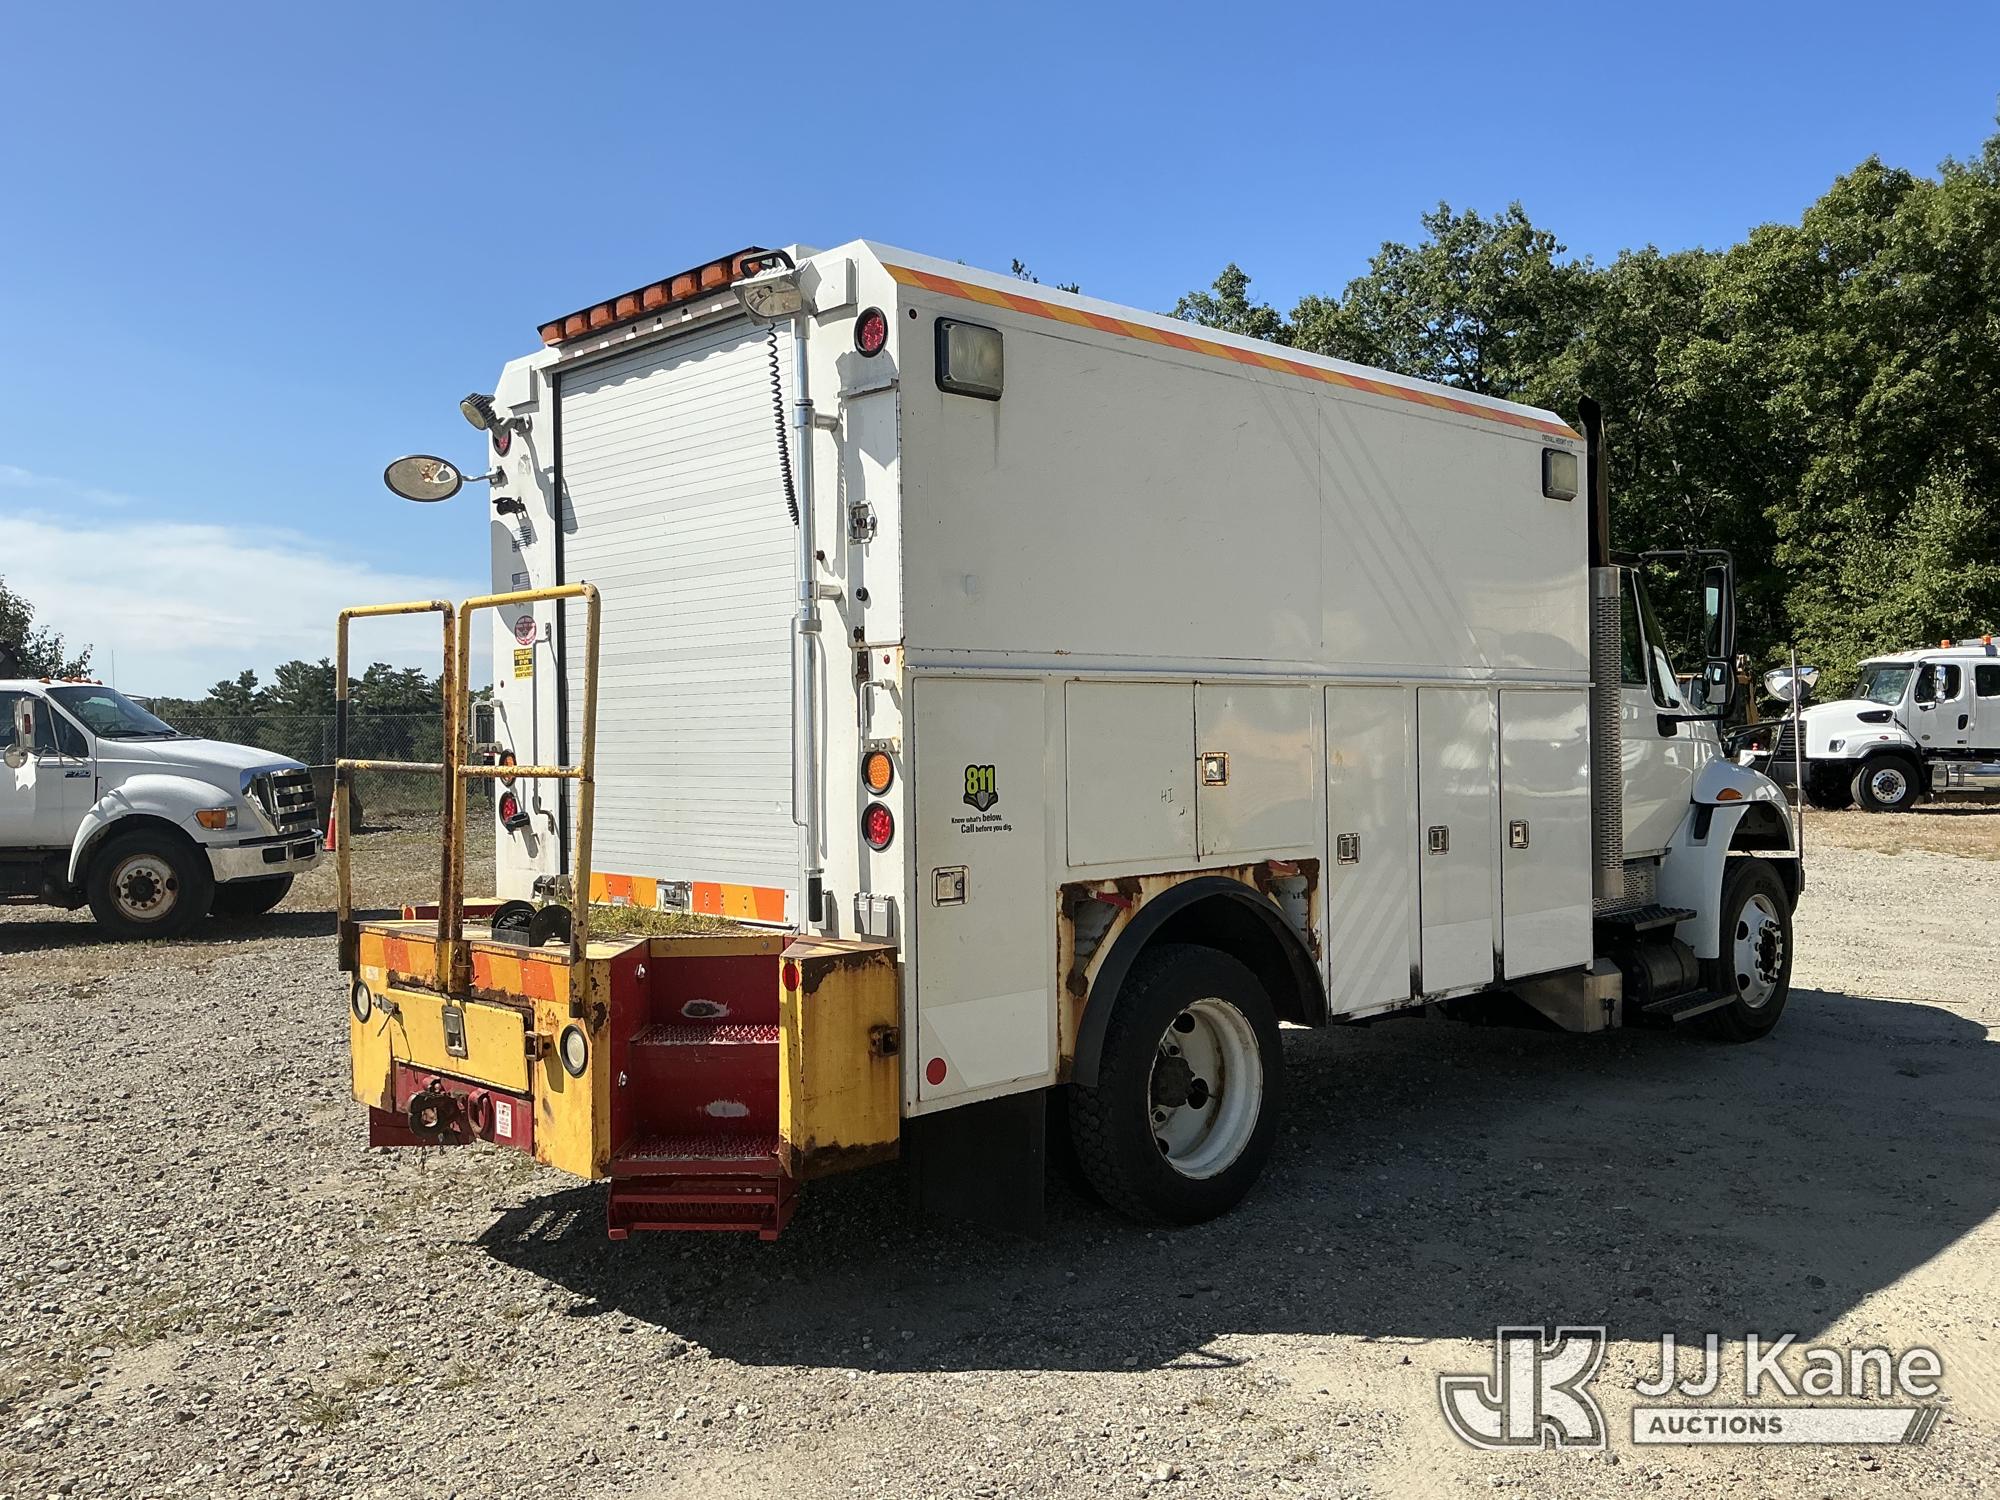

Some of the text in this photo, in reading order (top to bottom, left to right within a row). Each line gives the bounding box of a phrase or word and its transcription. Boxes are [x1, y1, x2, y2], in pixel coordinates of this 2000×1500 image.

[965, 765, 995, 795] 811
[966, 815, 981, 823] what's
[982, 813, 1002, 822] below.
[961, 823, 1013, 834] Call before you dig.
